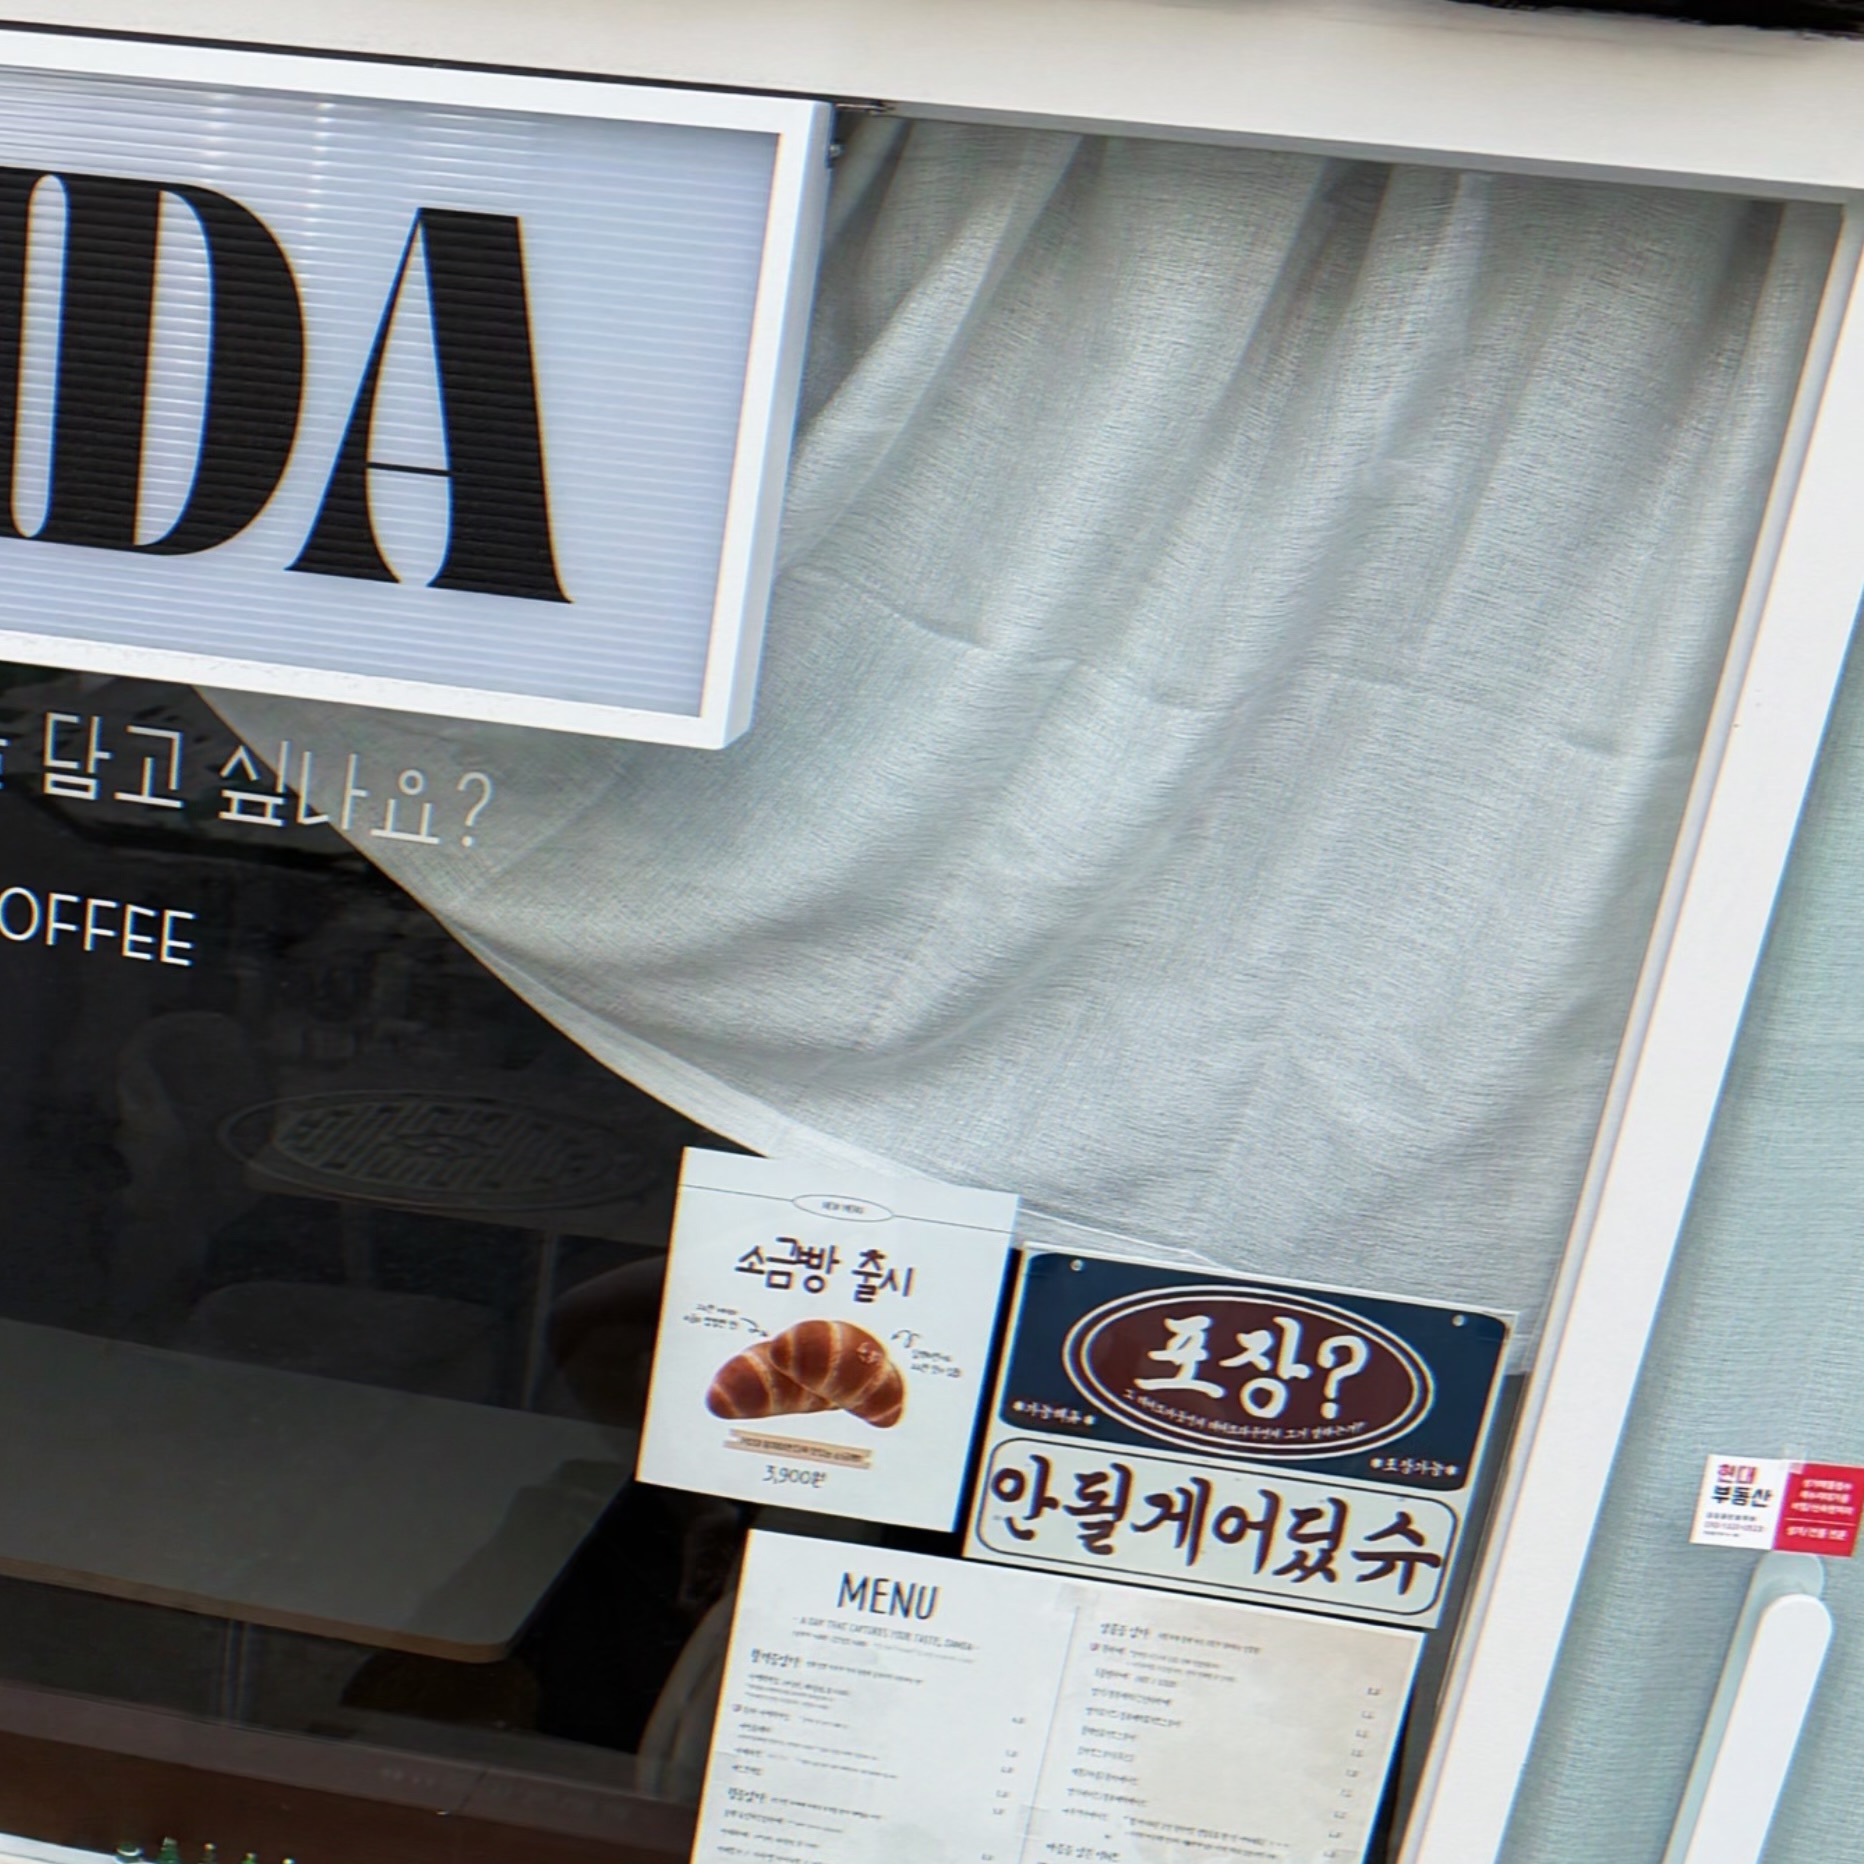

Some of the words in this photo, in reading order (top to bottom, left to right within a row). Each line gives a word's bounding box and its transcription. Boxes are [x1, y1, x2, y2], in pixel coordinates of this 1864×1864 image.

[42, 710, 184, 808] 담고
[218, 739, 494, 848] 싶나요?
[734, 1236, 842, 1294] 소금빵
[851, 1248, 915, 1303] 출시
[1133, 1314, 1370, 1420] 포장?
[762, 1464, 827, 1488] 3,900원
[1711, 1485, 1773, 1508] 부동산
[836, 1571, 941, 1621] MENU
